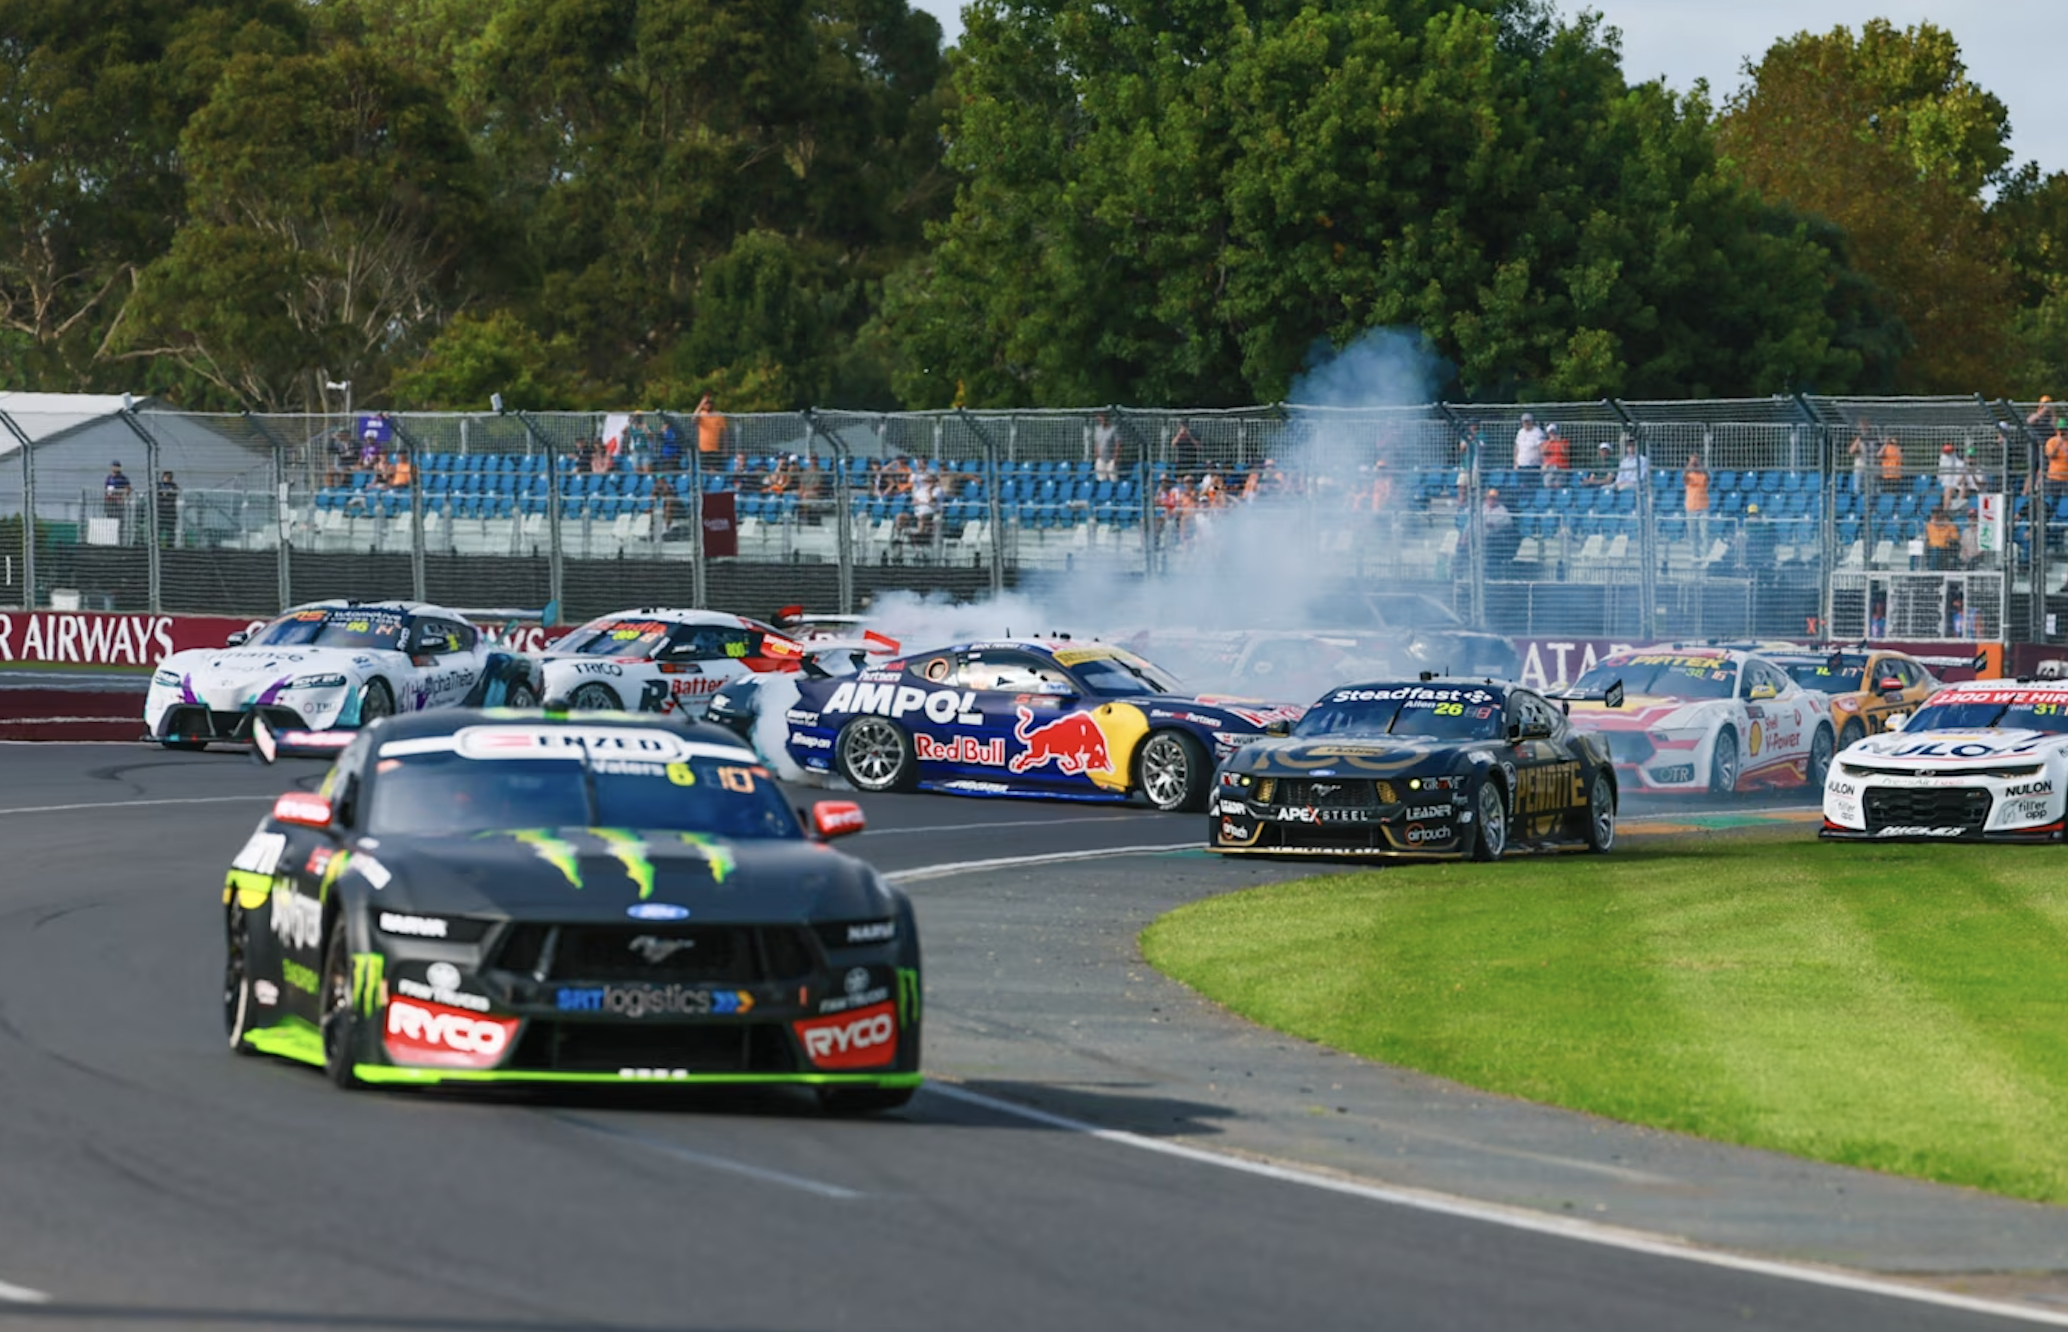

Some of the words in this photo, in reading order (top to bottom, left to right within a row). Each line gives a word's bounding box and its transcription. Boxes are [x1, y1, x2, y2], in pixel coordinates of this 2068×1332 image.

[21, 614, 174, 664] AIRWAYS
[725, 641, 746, 657] 800
[571, 662, 623, 677] TRICO
[1628, 655, 1727, 669] PIRTEK
[1333, 686, 1462, 703] Steadfast
[1992, 691, 2029, 703] WE
[1433, 702, 1464, 717] 26
[2033, 702, 2057, 715] 31
[1765, 714, 1779, 731] Shell
[539, 735, 662, 751] ENZED
[913, 733, 960, 760] Red
[962, 735, 1005, 766] Bull
[1765, 732, 1801, 752] V-Power
[666, 762, 696, 787] 6
[716, 766, 756, 794] 10
[1514, 760, 1588, 815] PENRITE
[2005, 780, 2053, 798] NULON
[1277, 805, 1322, 825] APEX
[1322, 810, 1369, 821] STEEL
[1406, 804, 1452, 821] LEADER
[1406, 825, 1451, 843] airtouch
[388, 1001, 507, 1056] RYCO
[803, 1012, 894, 1058] RYCO
